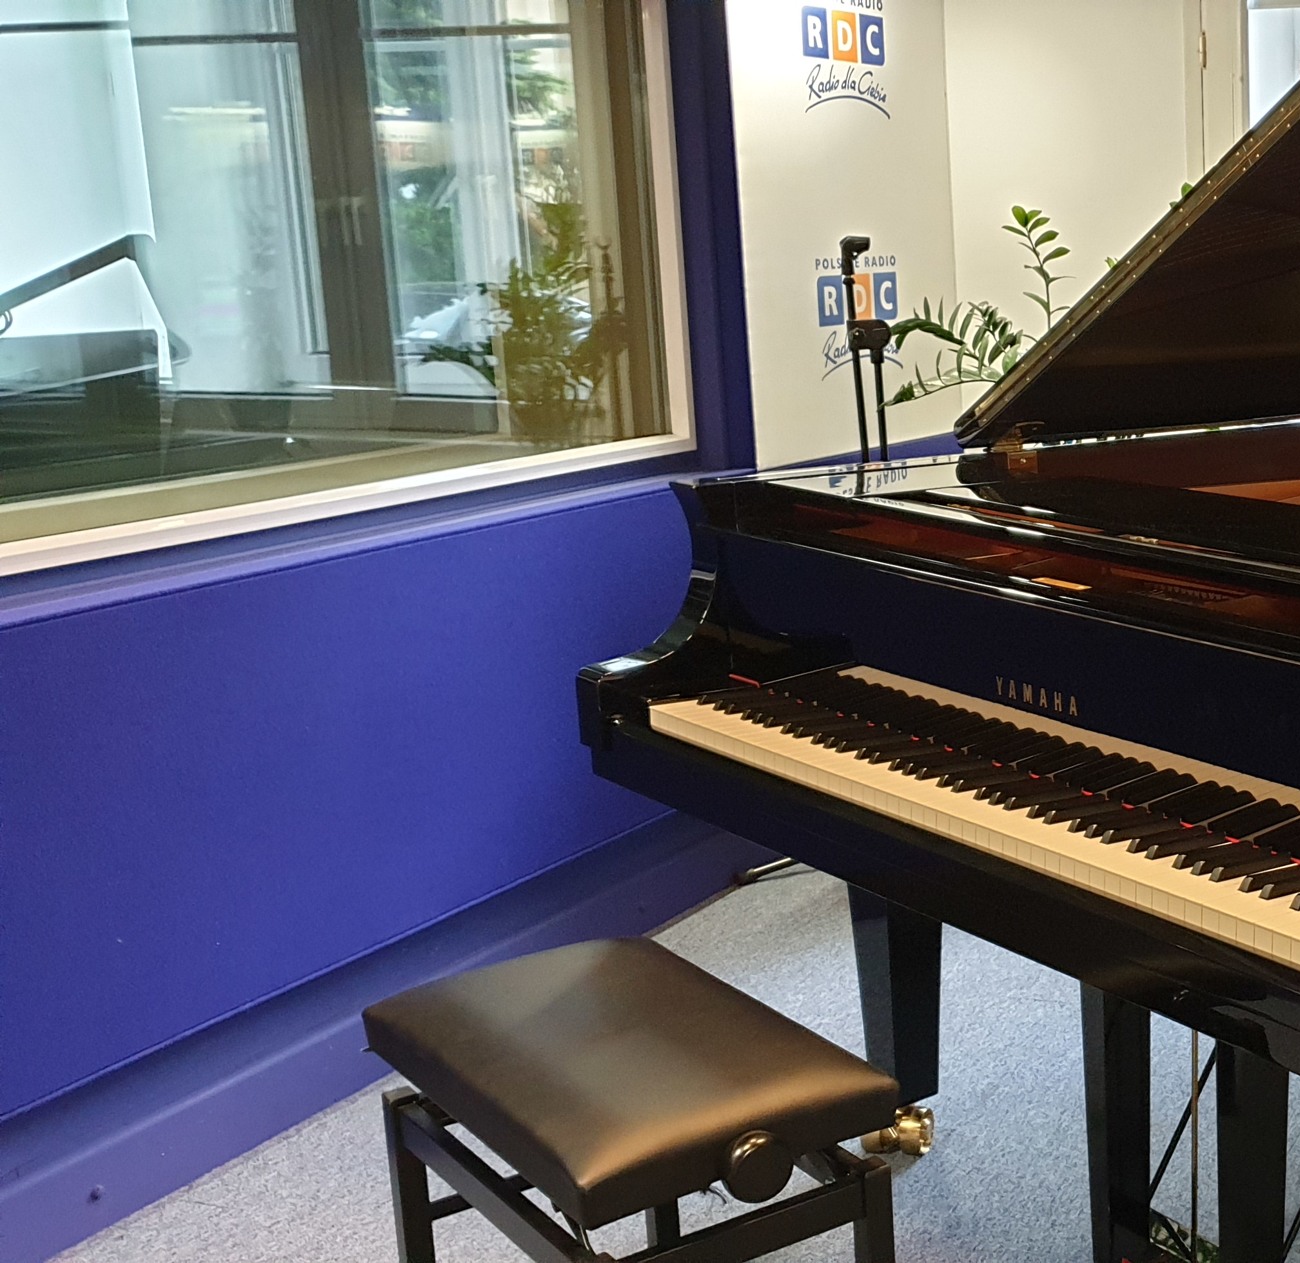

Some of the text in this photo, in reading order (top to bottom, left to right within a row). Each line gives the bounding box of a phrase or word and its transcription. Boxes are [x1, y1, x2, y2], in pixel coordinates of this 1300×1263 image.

[806, 14, 881, 56] RDC
[806, 63, 888, 103] Radio dla Ciebie
[815, 255, 896, 270] POLSE RADIO
[823, 280, 894, 316] RDC
[995, 675, 1078, 717] YAMAHA
